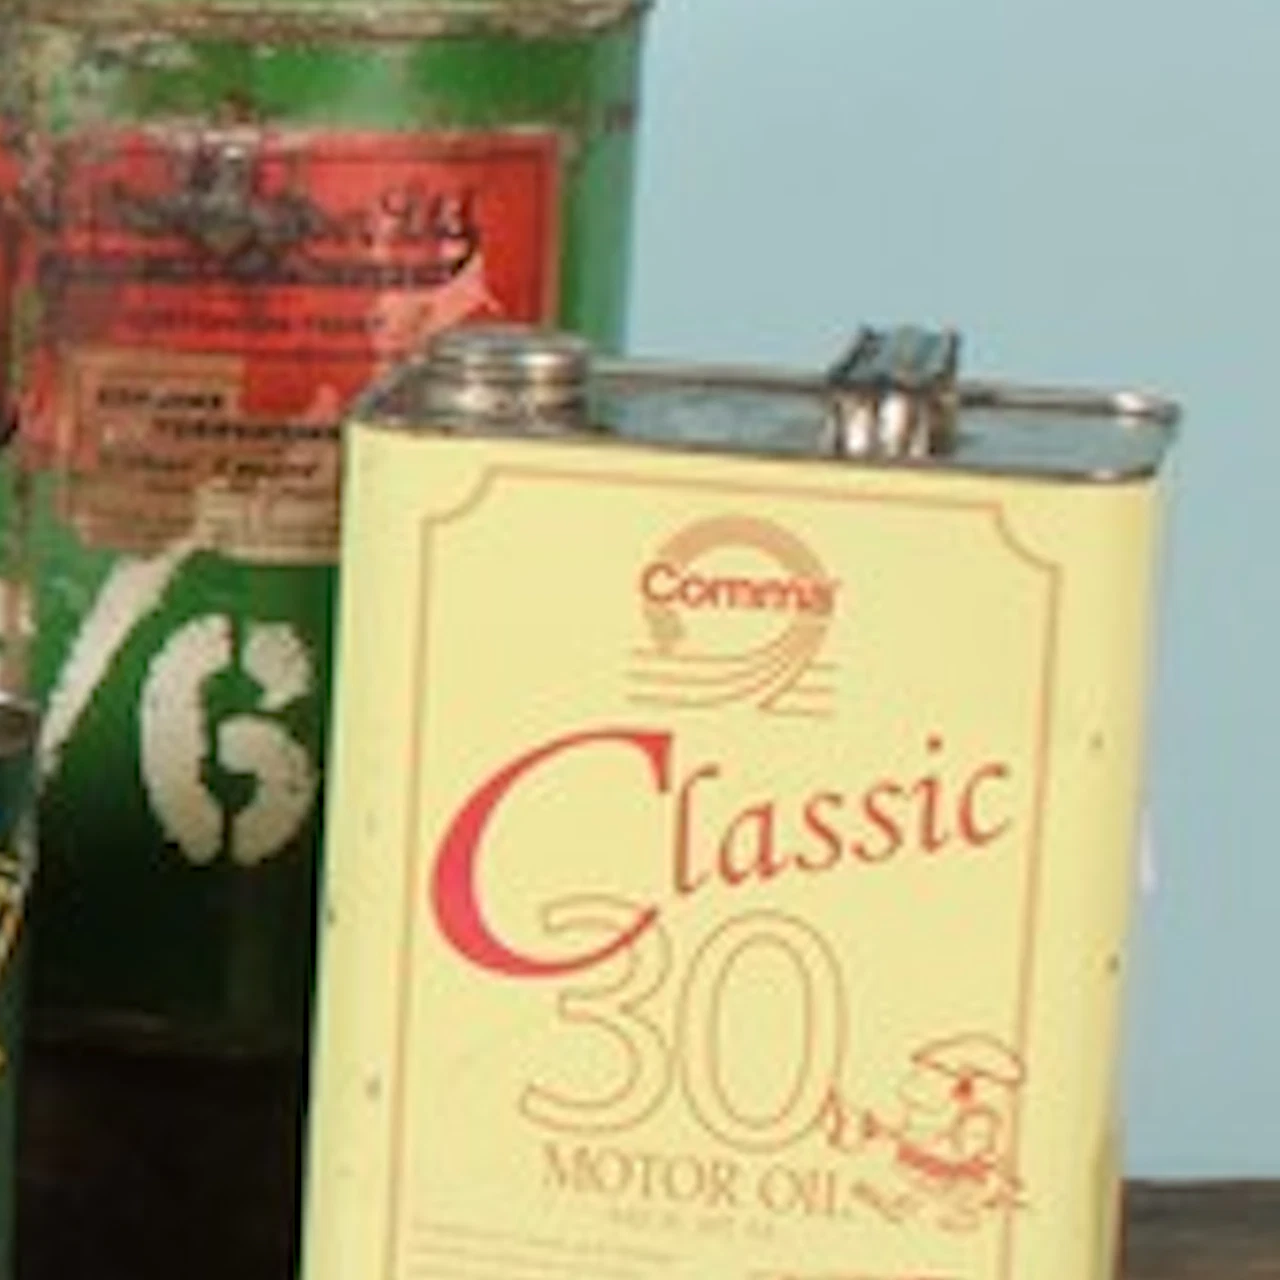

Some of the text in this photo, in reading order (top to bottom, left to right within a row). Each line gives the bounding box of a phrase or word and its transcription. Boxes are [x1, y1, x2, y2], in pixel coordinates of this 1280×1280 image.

[641, 562, 835, 618] Comma
[429, 727, 1013, 979] Classic
[519, 894, 851, 1154] 30
[541, 1142, 852, 1218] MOTOR OIL
